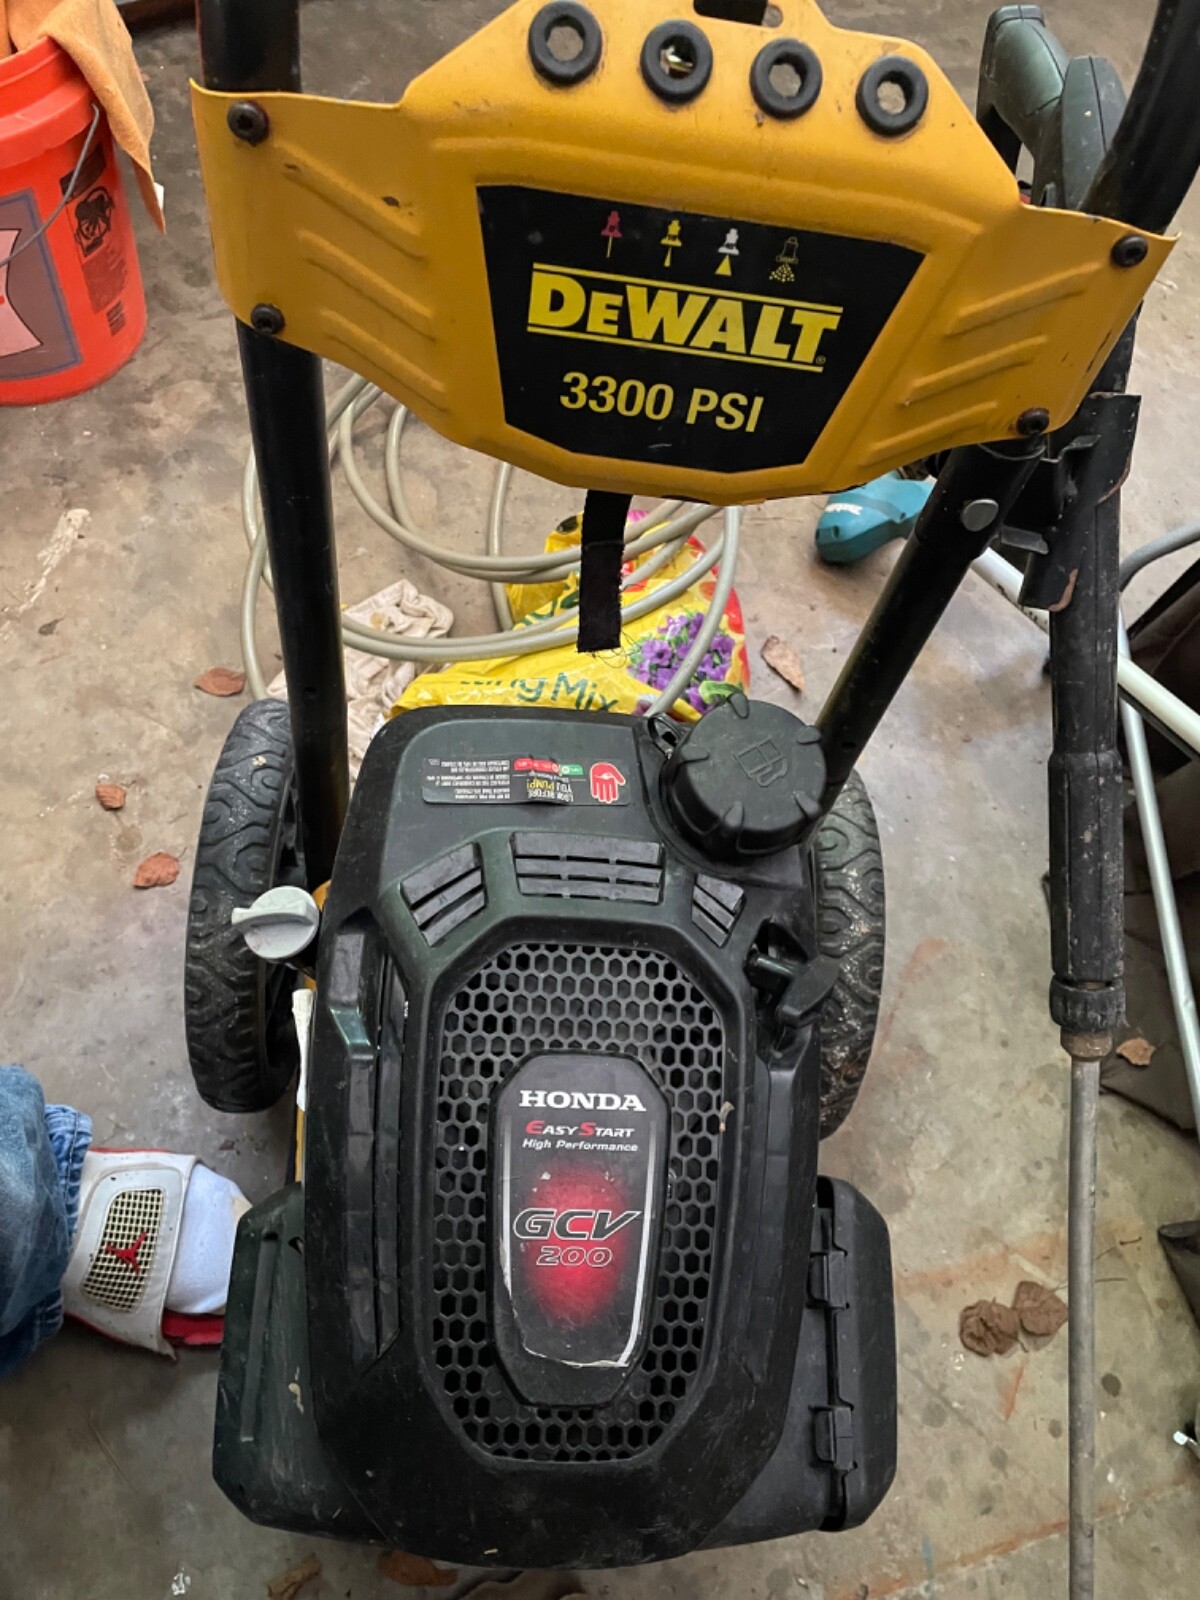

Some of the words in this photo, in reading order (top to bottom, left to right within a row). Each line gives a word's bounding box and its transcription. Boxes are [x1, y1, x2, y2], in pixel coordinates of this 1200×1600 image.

[560, 371, 674, 421] 3300
[686, 388, 764, 433] PSI
[550, 672, 618, 711] Mix
[519, 1090, 647, 1112] HONDA
[522, 1138, 552, 1150] High
[556, 1140, 639, 1152] Performance
[513, 1208, 642, 1241] GCV
[536, 1246, 613, 1268] 200
